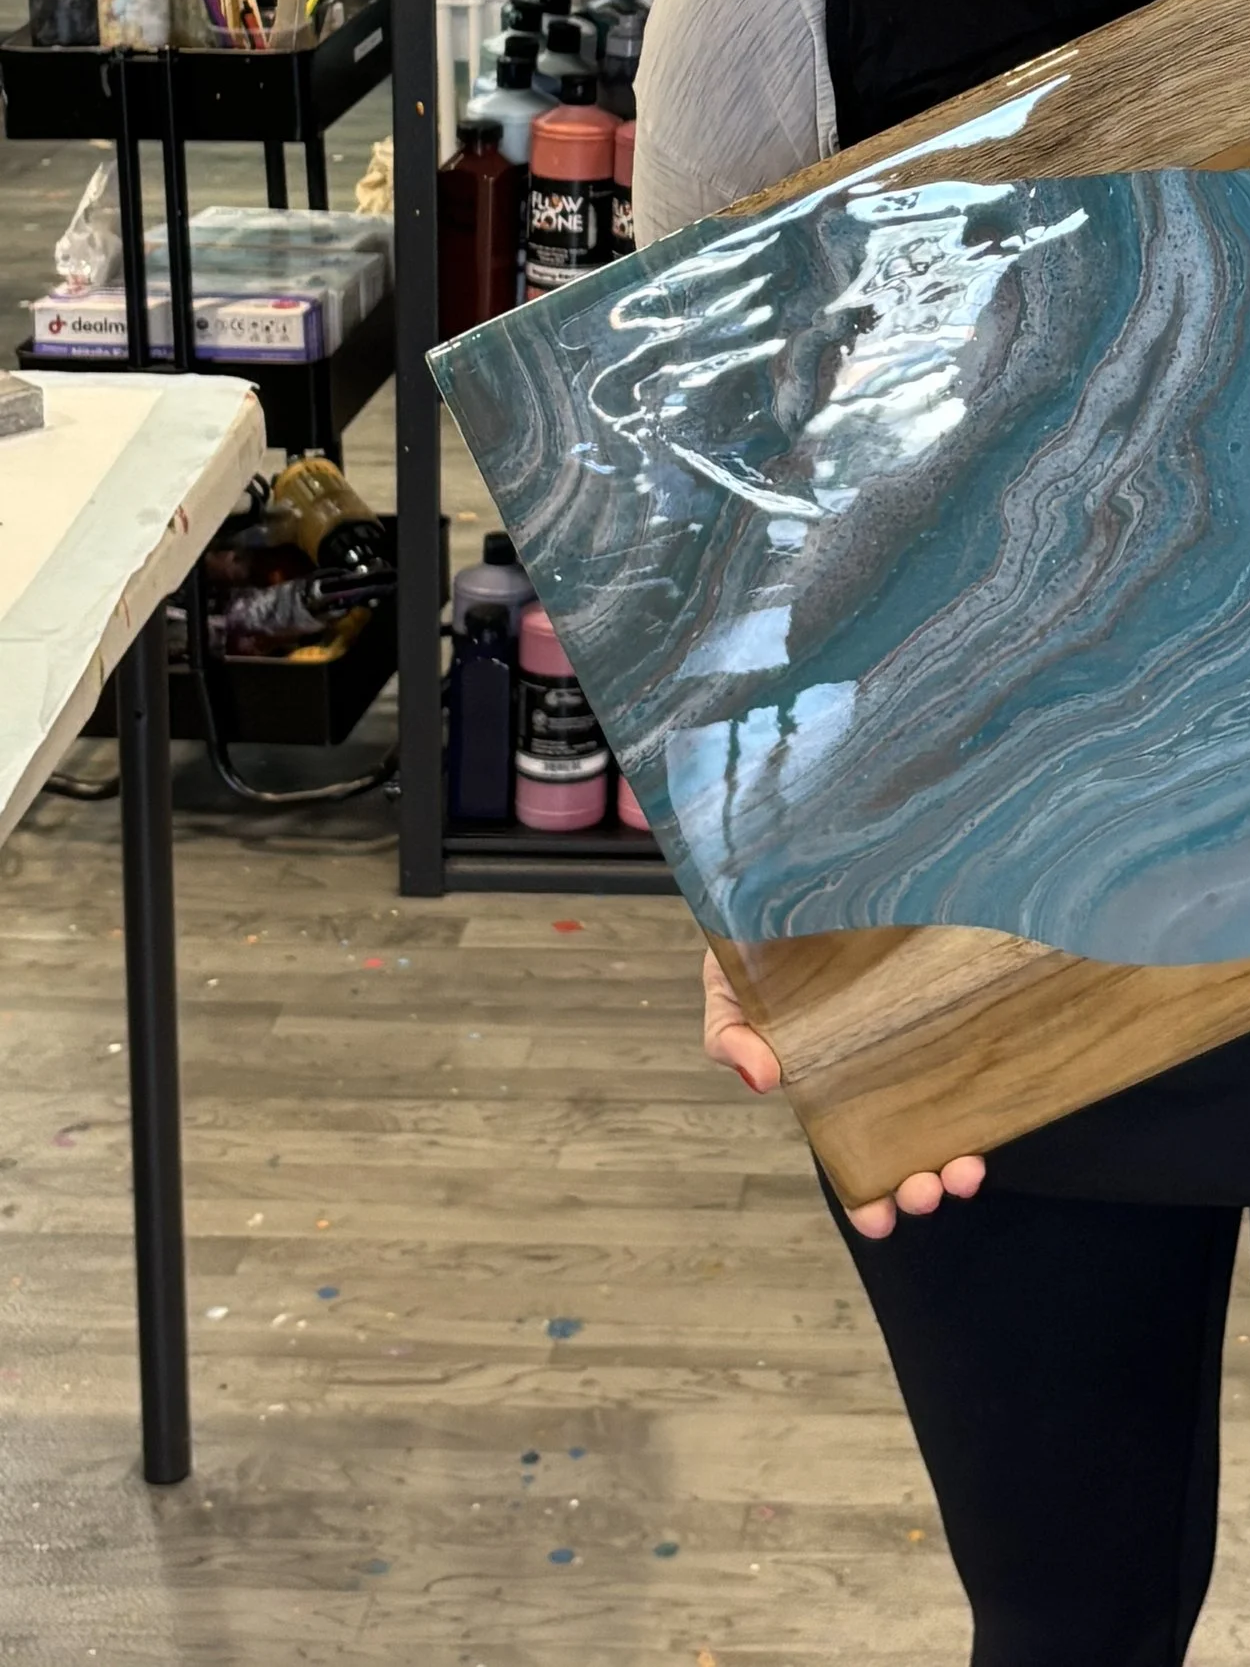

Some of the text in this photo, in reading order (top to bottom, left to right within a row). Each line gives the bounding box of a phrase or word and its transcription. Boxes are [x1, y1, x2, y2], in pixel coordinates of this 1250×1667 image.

[531, 190, 584, 214] FLOW
[531, 209, 584, 233] ZONE
[71, 316, 126, 334] dealm
